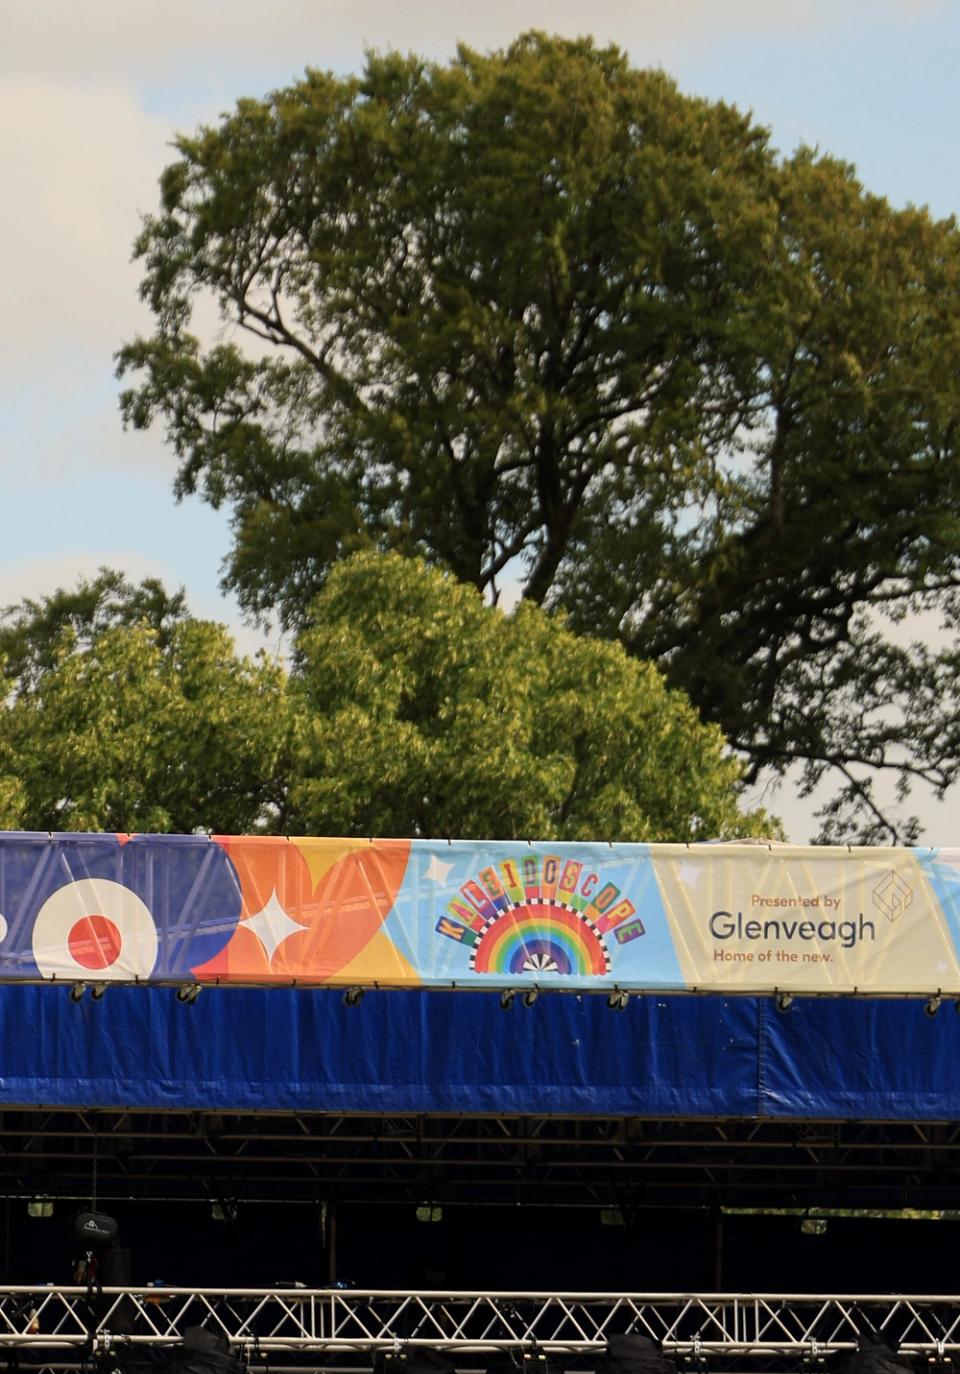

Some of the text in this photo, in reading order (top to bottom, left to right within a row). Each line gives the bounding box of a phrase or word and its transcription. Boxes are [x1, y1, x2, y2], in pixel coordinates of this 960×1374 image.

[437, 855, 644, 943] KALEIDOSCOPE
[751, 894, 841, 910] Presented by
[708, 910, 875, 948] Glenveagh
[713, 949, 834, 962] Home of the new.
